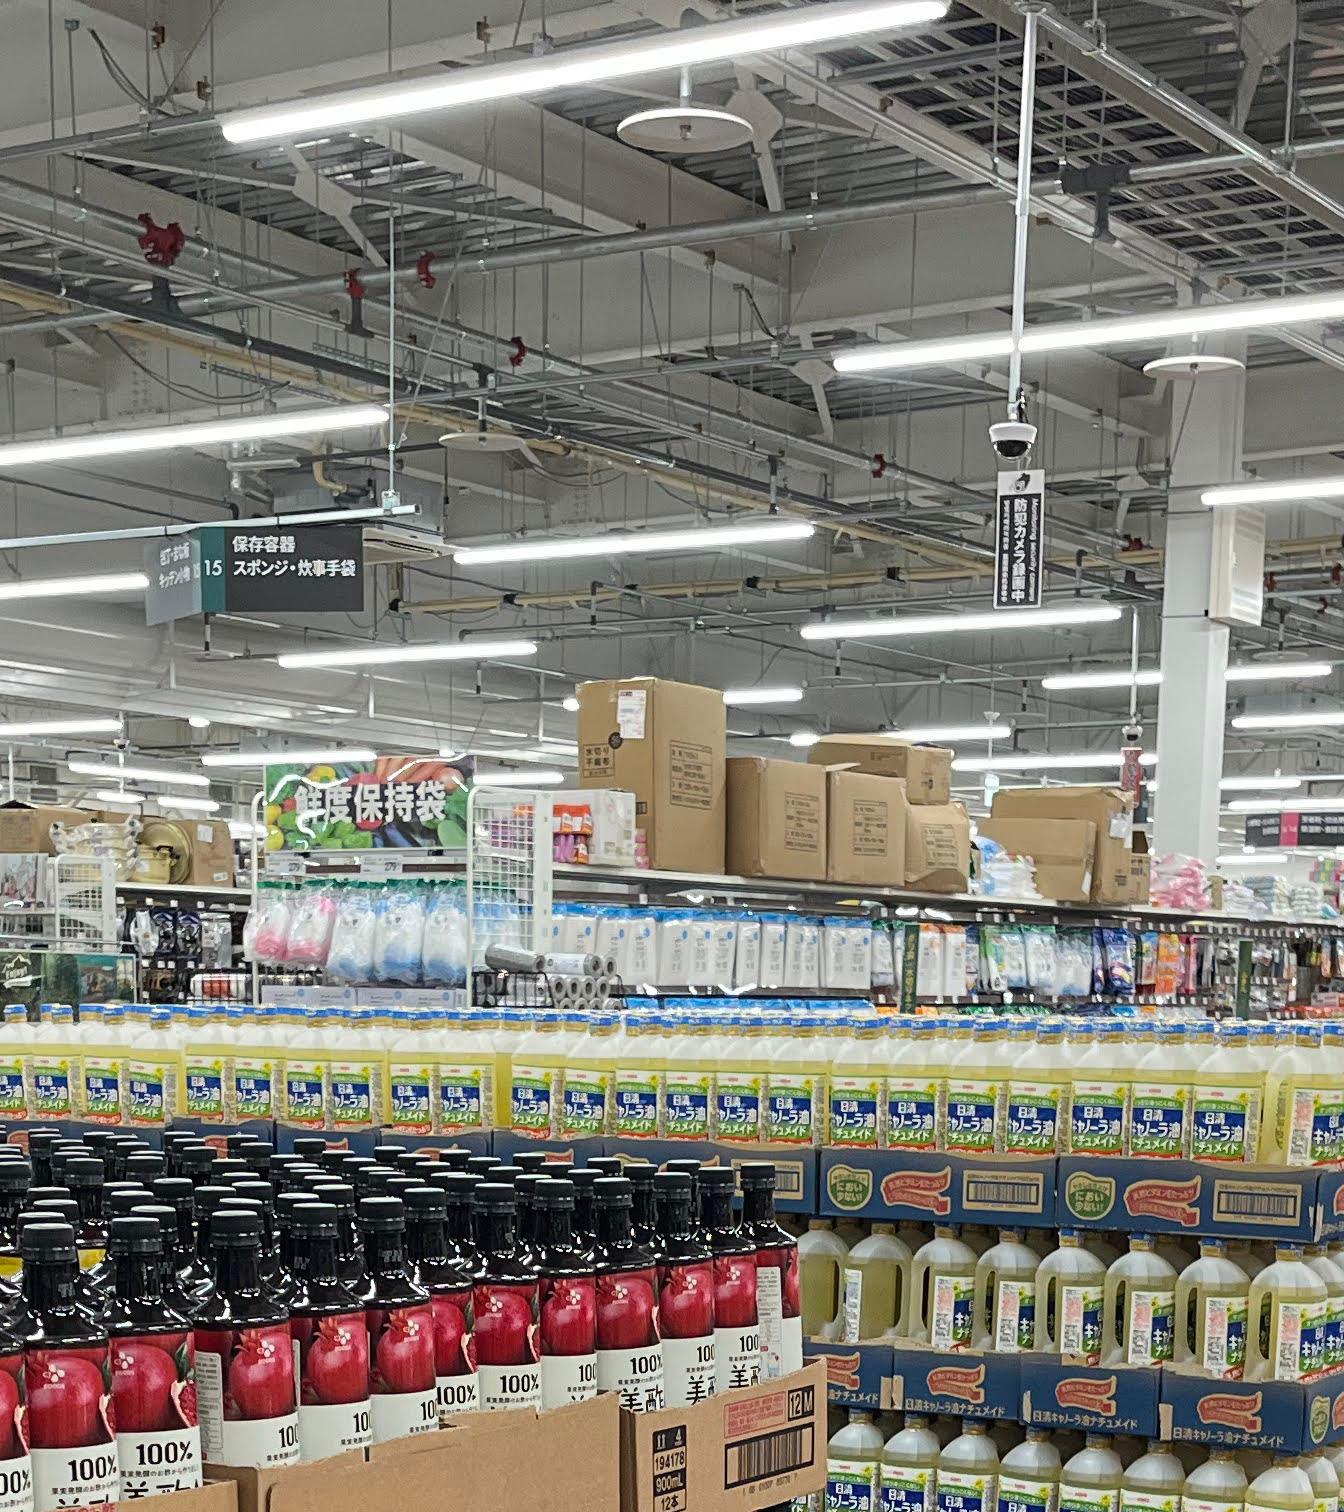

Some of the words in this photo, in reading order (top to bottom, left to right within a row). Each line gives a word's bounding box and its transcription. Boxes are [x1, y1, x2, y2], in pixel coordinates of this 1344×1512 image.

[233, 536, 295, 553] 保存容器
[205, 560, 222, 576] 15
[234, 559, 356, 577] スポンジ・炊事手袋
[295, 781, 446, 824] 鮮度保持袋
[136, 1441, 194, 1467] 100%
[656, 1452, 684, 1470] 194178
[657, 1473, 683, 1493] 900mL
[662, 1495, 678, 1510] 12本
